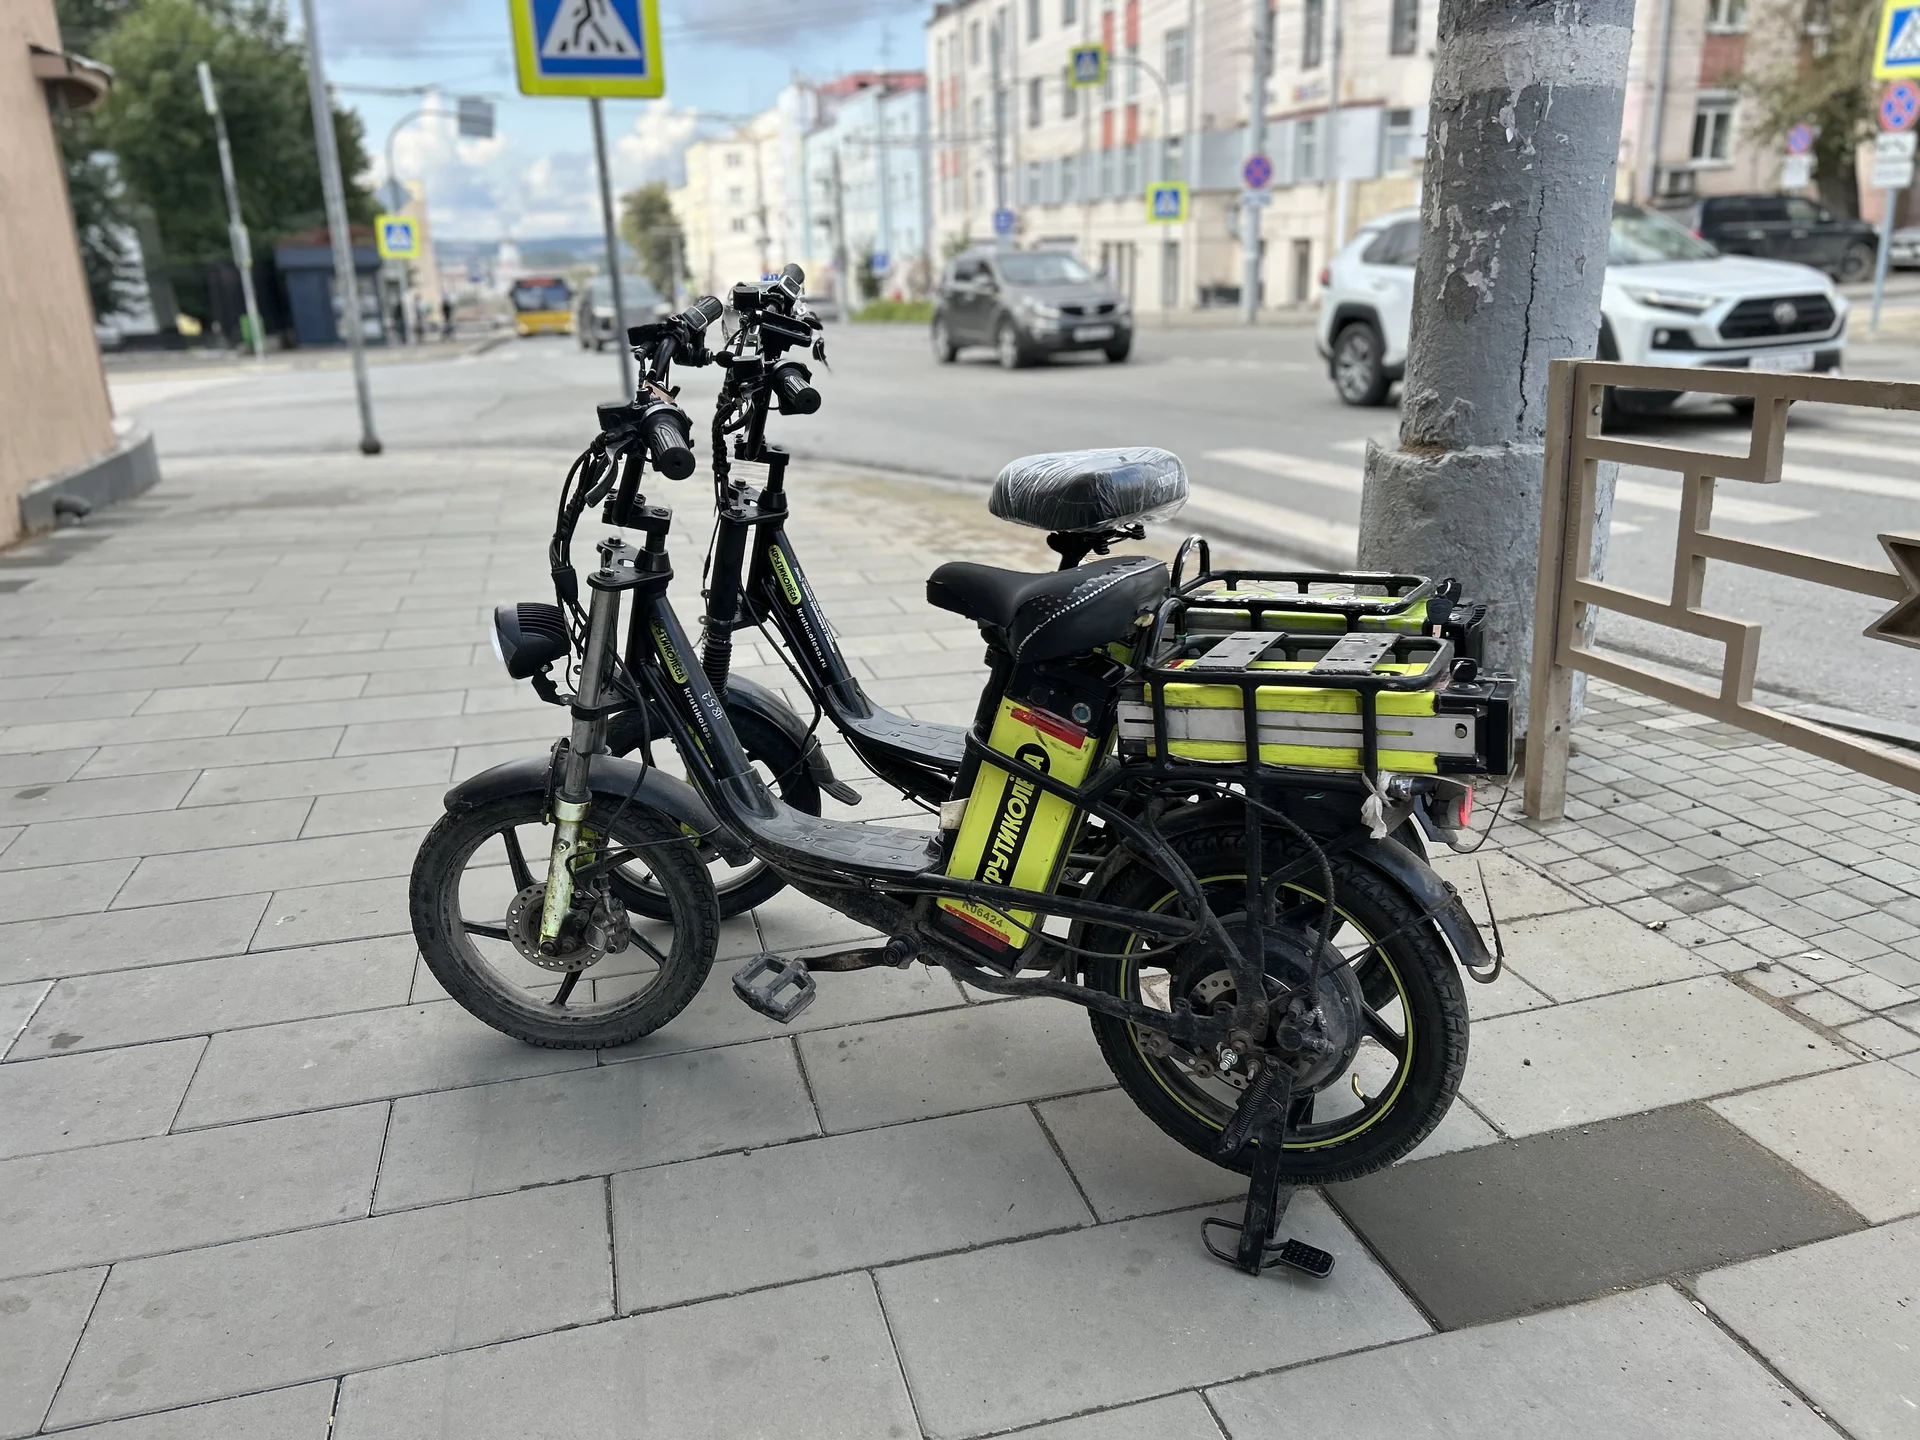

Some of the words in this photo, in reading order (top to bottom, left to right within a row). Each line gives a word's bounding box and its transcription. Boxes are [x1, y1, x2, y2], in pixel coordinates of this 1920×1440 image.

[769, 547, 799, 603] КРУТИКОЛЁСА
[701, 691, 723, 720] 4852
[982, 753, 1045, 884] РУТИКОЛЁА
